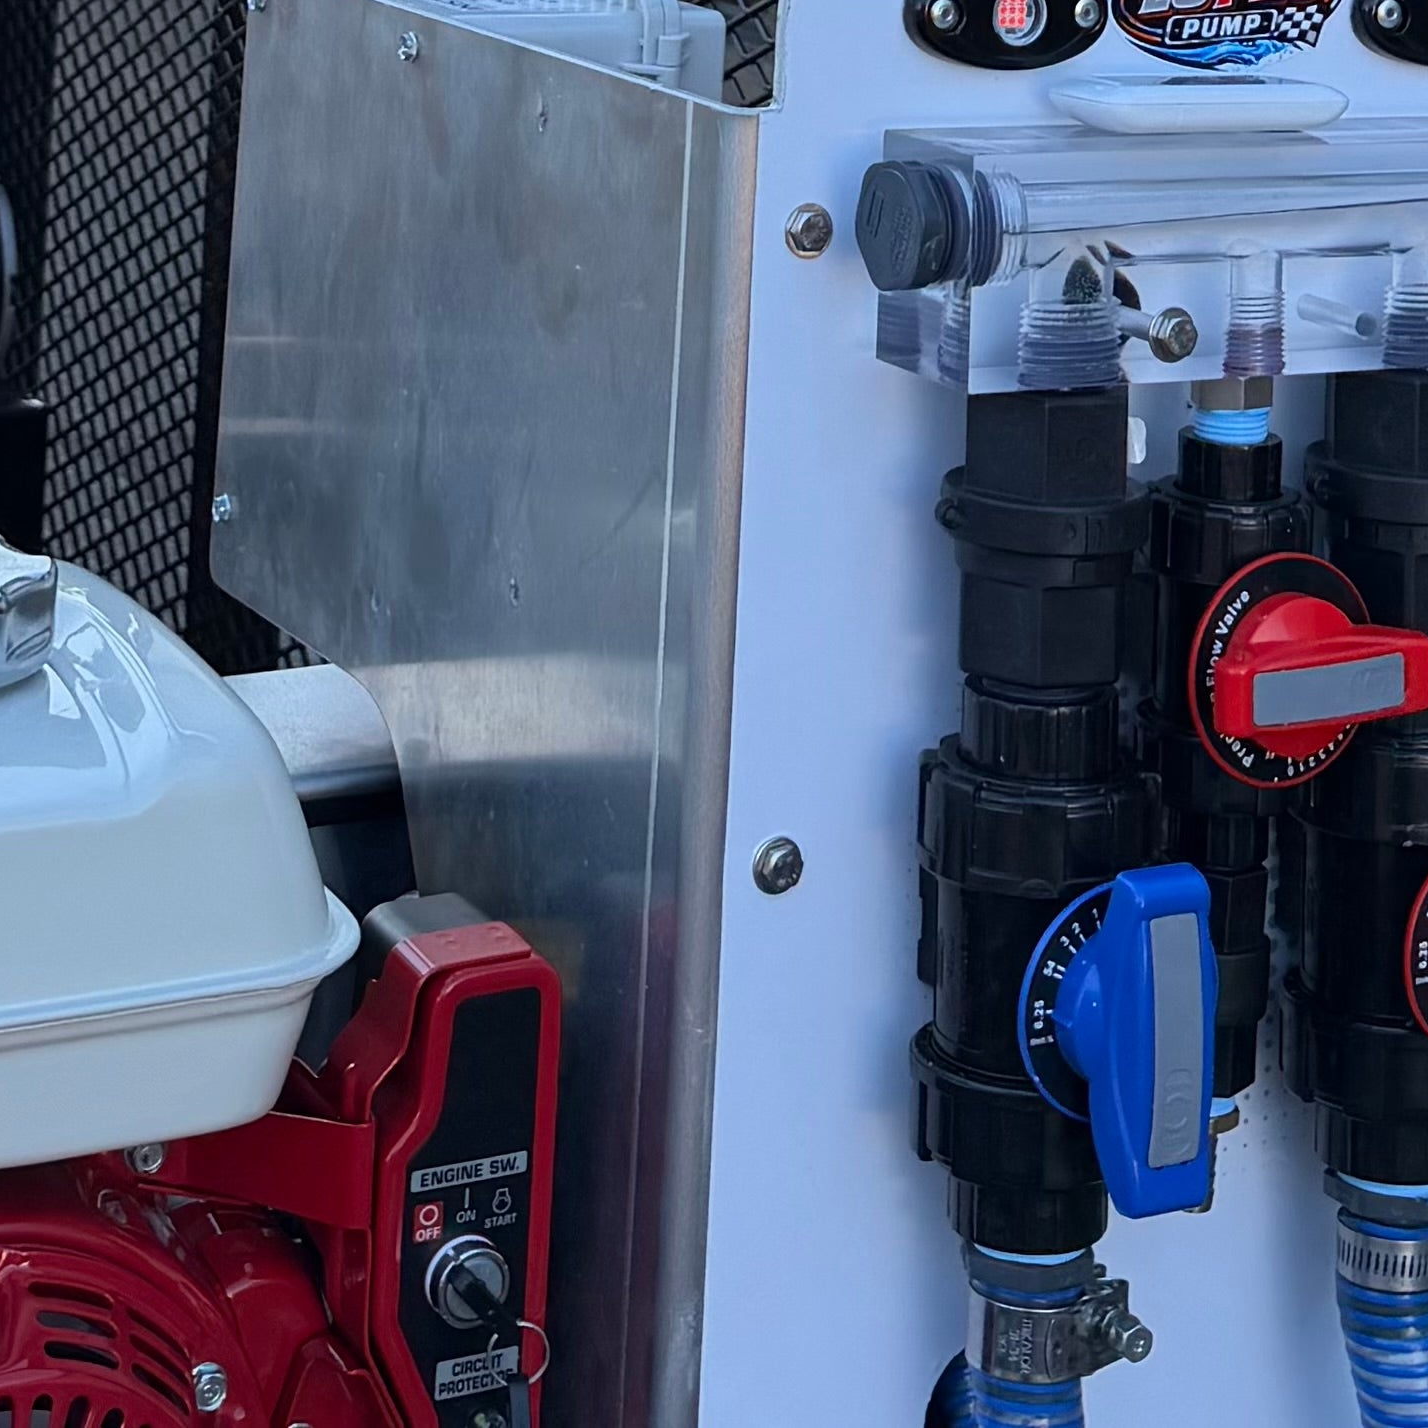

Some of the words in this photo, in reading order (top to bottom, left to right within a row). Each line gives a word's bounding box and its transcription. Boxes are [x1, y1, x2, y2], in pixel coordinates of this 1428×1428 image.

[1182, 14, 1262, 39] PUMP
[1215, 590, 1250, 637] Valve
[1060, 935, 1070, 947] 3
[1072, 922, 1081, 934] 2
[420, 1163, 484, 1188] ENGINE
[490, 1156, 520, 1175] SW.
[456, 1209, 476, 1223] ON
[484, 1212, 518, 1229] START
[415, 1226, 441, 1243] OFF
